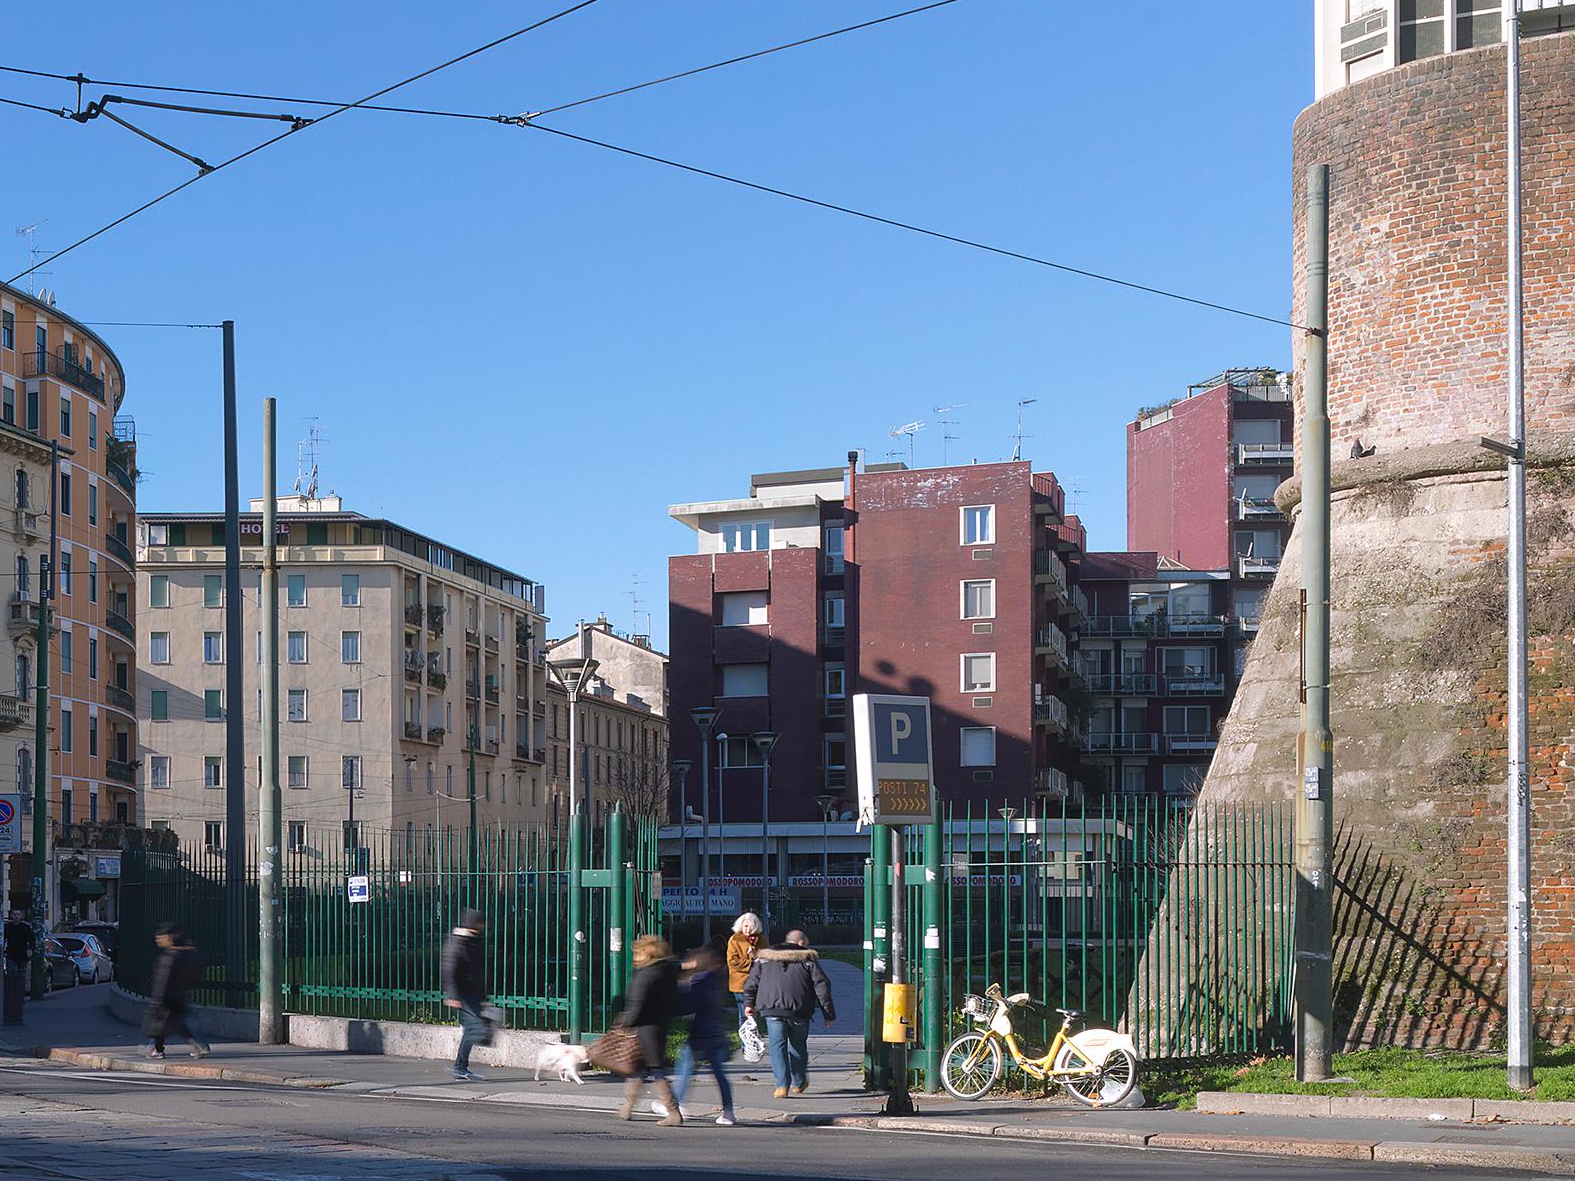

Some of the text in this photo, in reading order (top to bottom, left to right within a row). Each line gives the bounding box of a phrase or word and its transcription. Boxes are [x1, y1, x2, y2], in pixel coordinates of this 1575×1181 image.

[890, 711, 912, 755] P
[878, 781, 927, 795] POSTI 74
[706, 878, 773, 886] OSSOPOMODOO
[663, 888, 699, 896] PERTO
